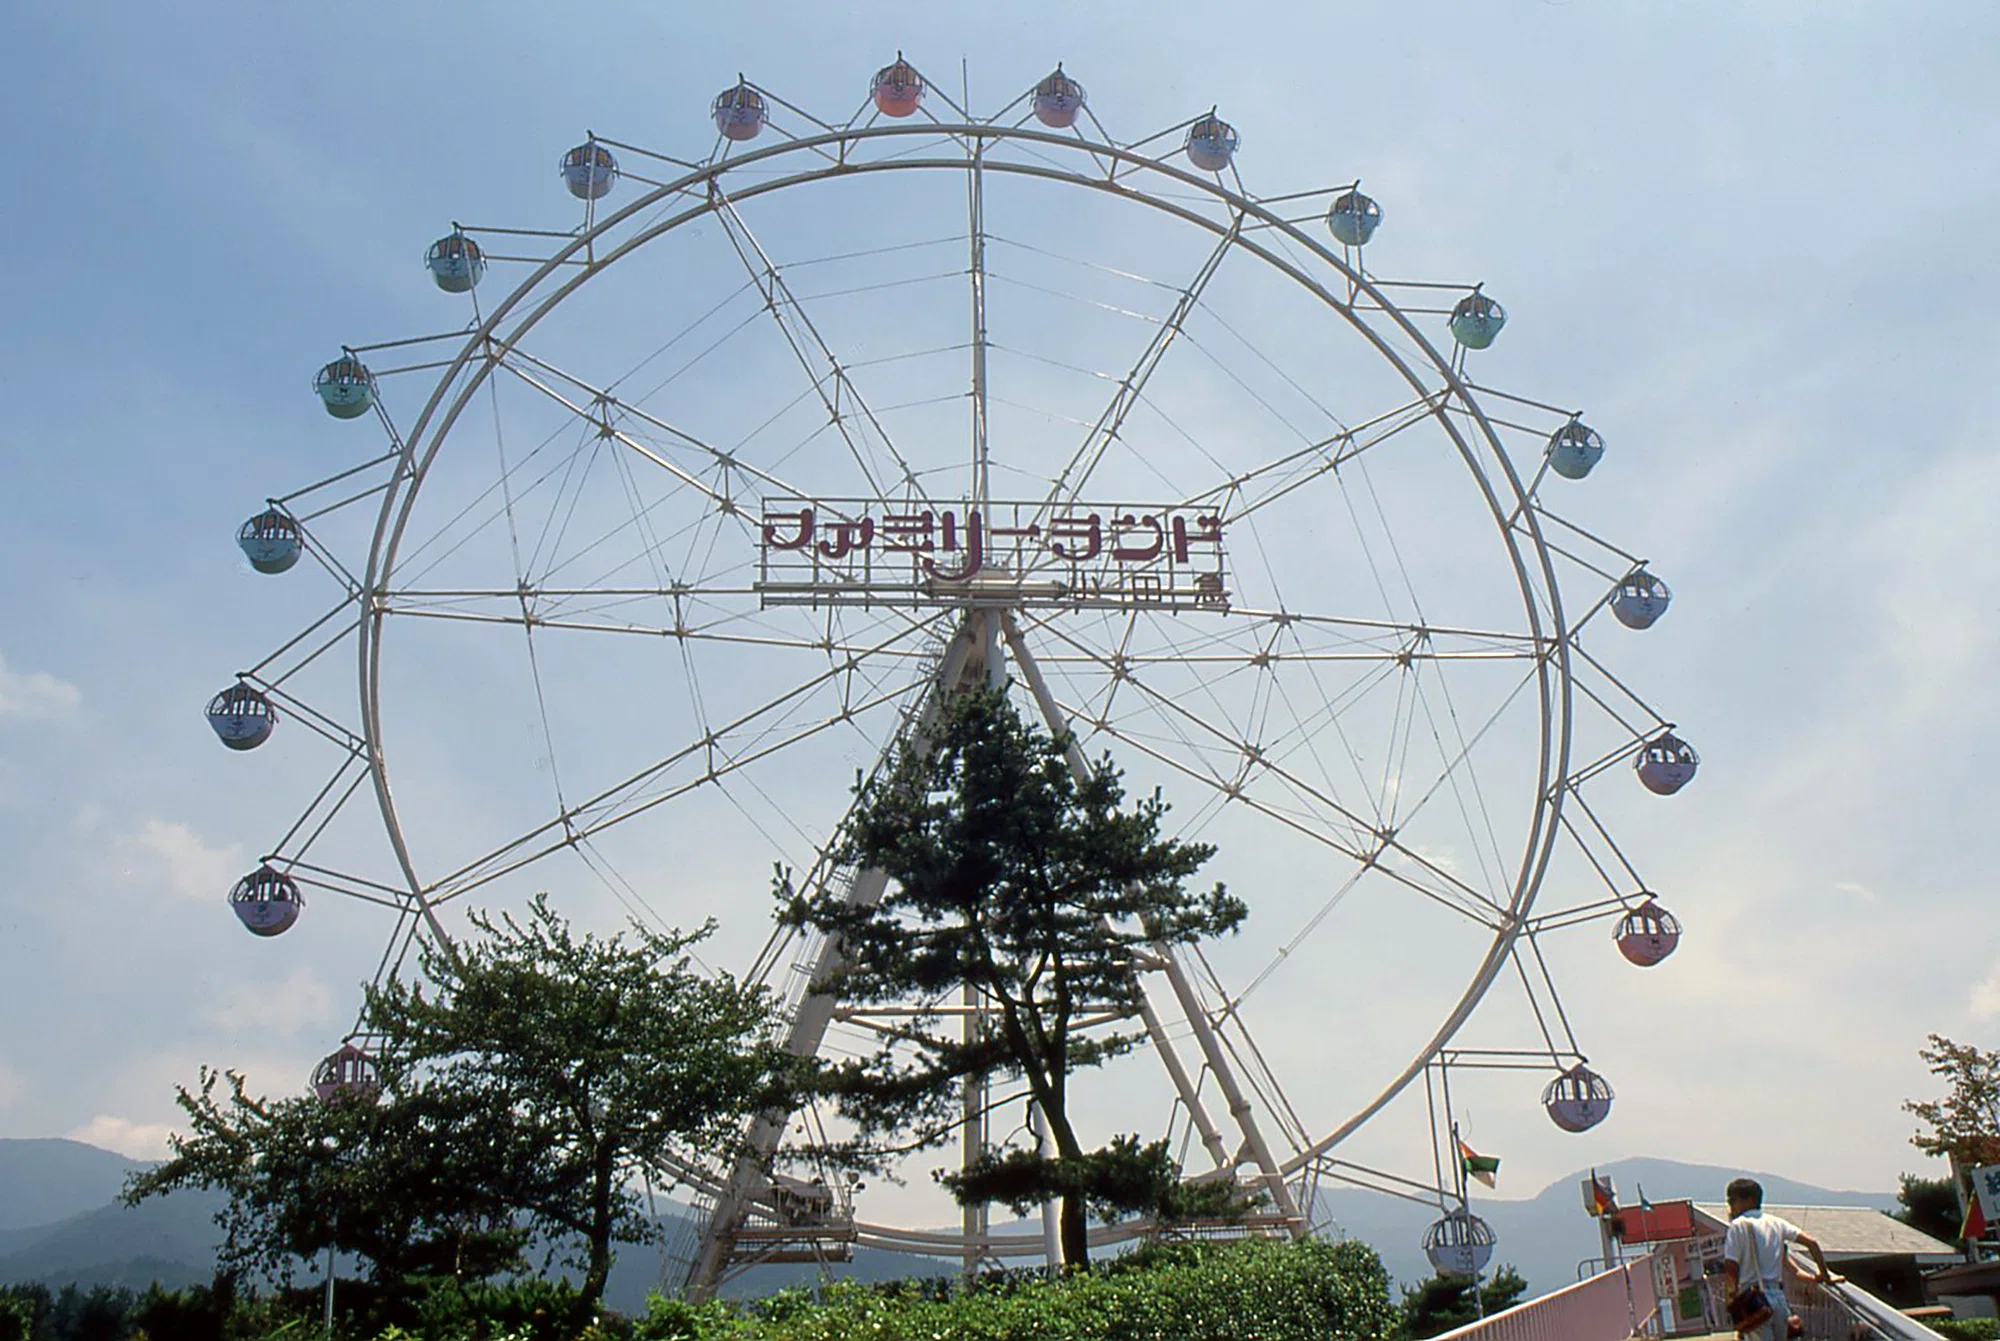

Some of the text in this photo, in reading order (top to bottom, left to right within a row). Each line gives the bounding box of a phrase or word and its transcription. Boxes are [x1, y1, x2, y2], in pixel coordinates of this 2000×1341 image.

[764, 508, 1222, 581] ファミリーランド
